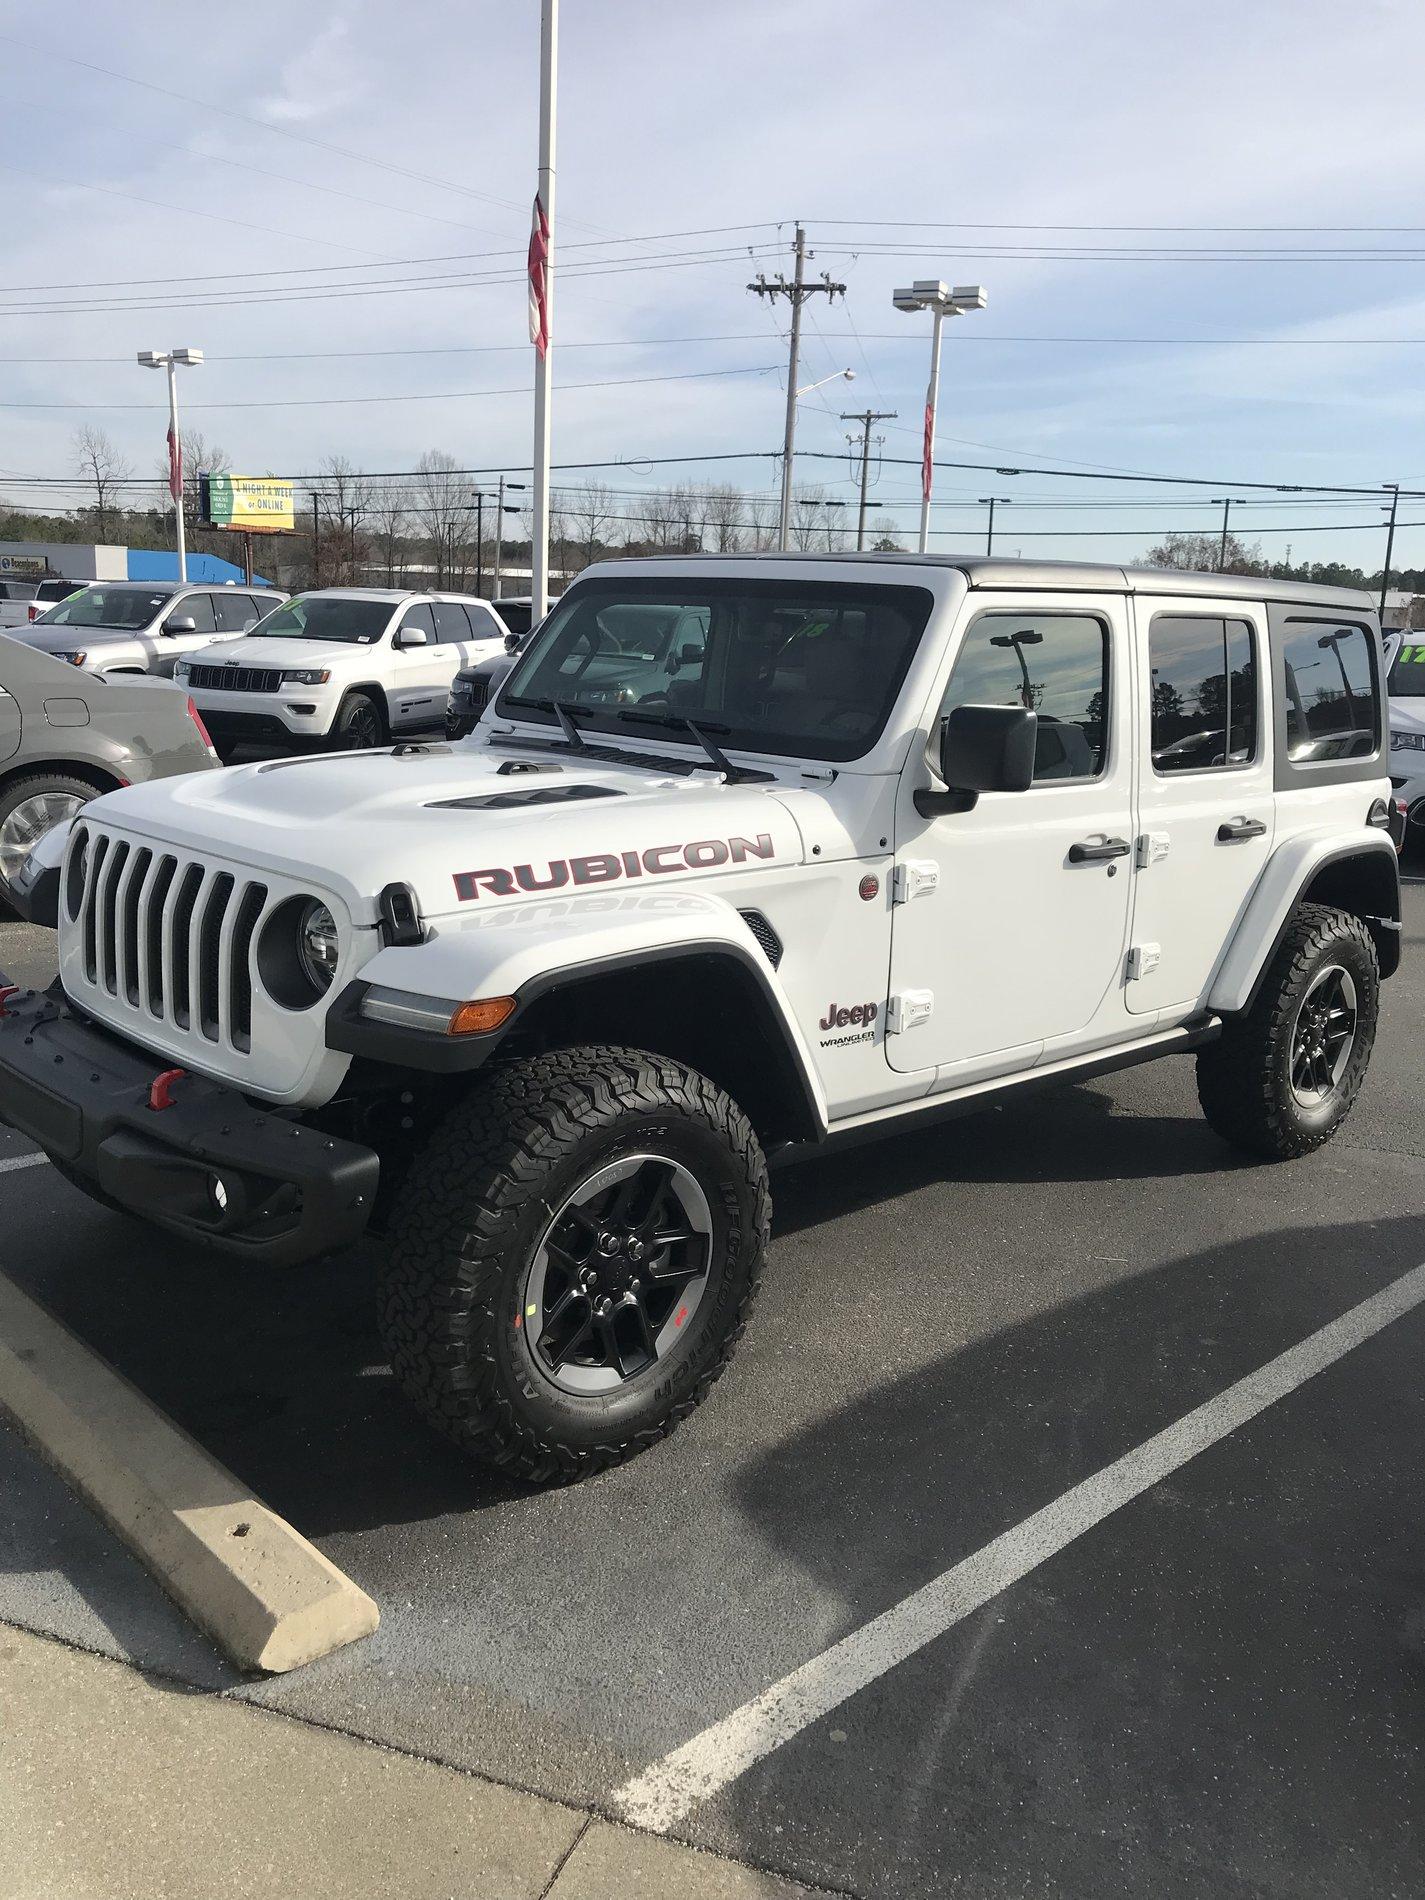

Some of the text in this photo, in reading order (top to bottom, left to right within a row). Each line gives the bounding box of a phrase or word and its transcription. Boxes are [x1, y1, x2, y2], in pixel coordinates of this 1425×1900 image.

[242, 483, 266, 495] NIGHT
[274, 486, 293, 498] WEEK
[257, 498, 284, 511] ONLINE
[452, 833, 775, 902] RUBICON
[819, 1002, 878, 1031] Jeep
[820, 1031, 875, 1048] WRANGLER
